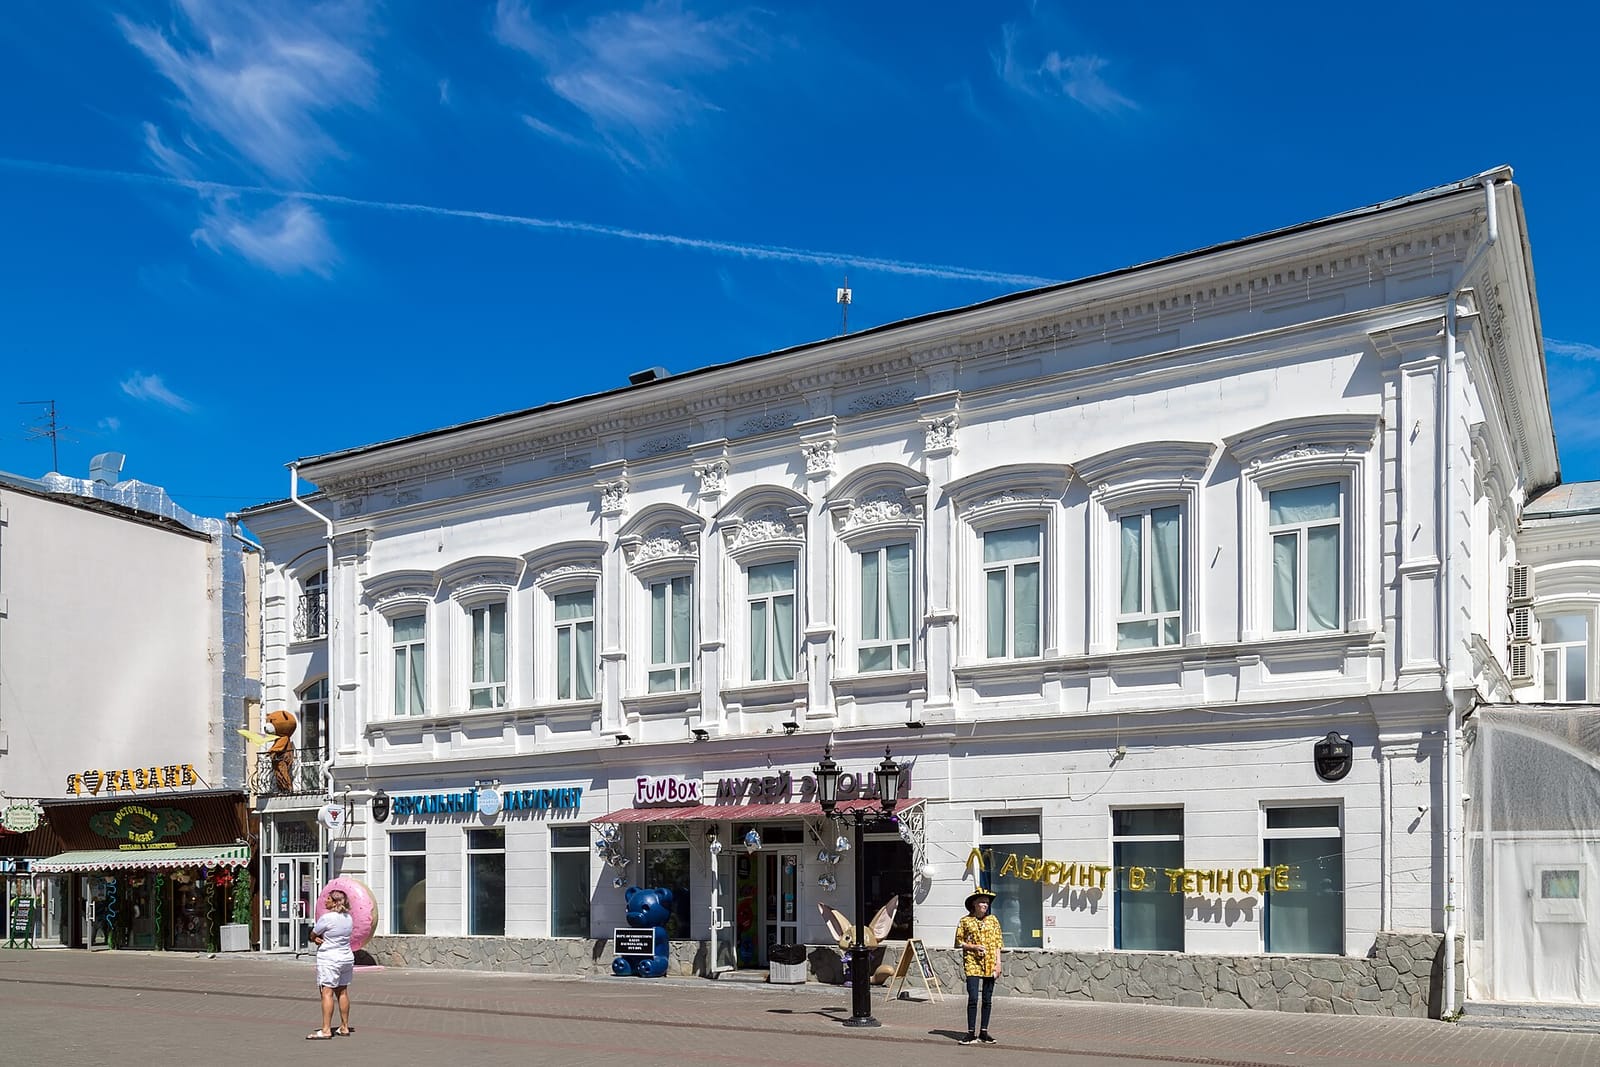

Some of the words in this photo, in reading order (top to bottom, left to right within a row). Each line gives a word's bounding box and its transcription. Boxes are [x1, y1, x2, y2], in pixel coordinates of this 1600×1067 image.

[66, 773, 81, 794] Я
[106, 764, 196, 790] КАЗАНЬ
[717, 770, 791, 798] МУЗЕЙ
[391, 787, 478, 815] ЗЕРКАЛЬНЫЙ
[503, 787, 584, 813] ЛАБИРИНТ
[128, 830, 155, 843] БАЗАР
[1128, 866, 1144, 888] В
[1165, 865, 1290, 893] ТЕМНОТЕ
